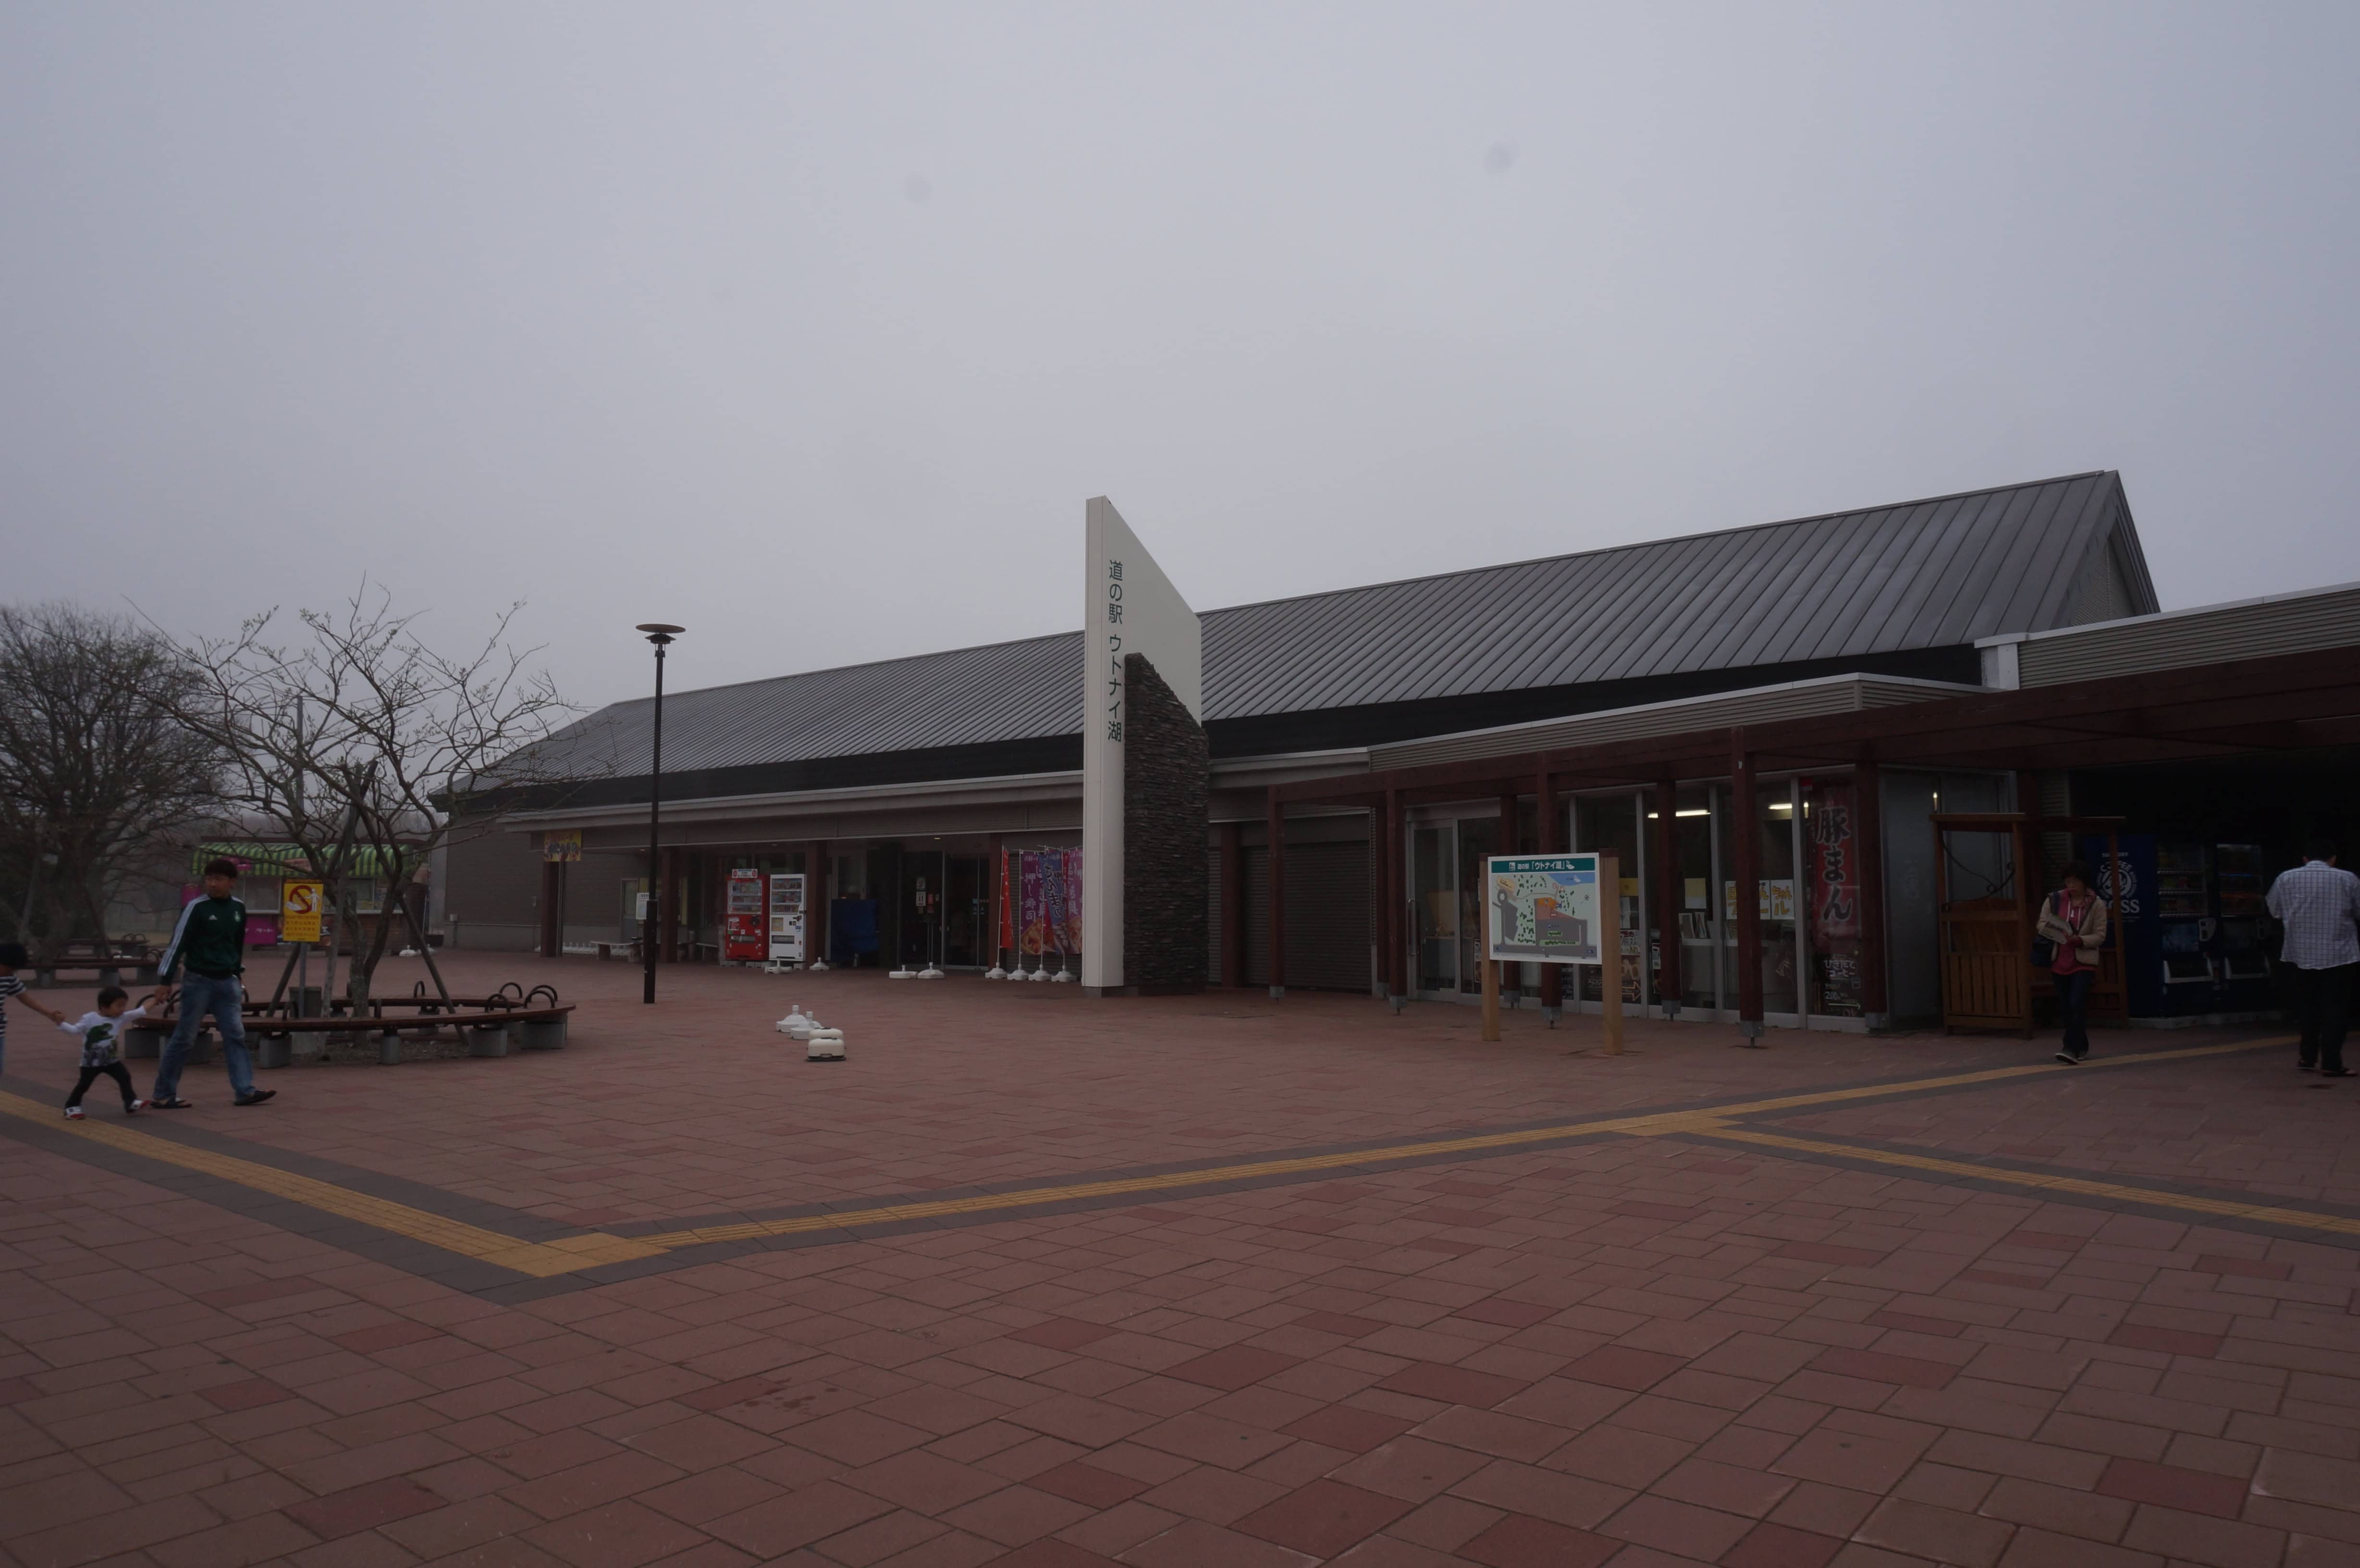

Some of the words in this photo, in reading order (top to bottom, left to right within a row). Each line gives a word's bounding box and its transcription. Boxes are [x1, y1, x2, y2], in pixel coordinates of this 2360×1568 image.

[1109, 560, 1123, 624] 道の駅
[1108, 634, 1122, 742] ウトナイ湖
[1816, 806, 1853, 921] 豚まん
